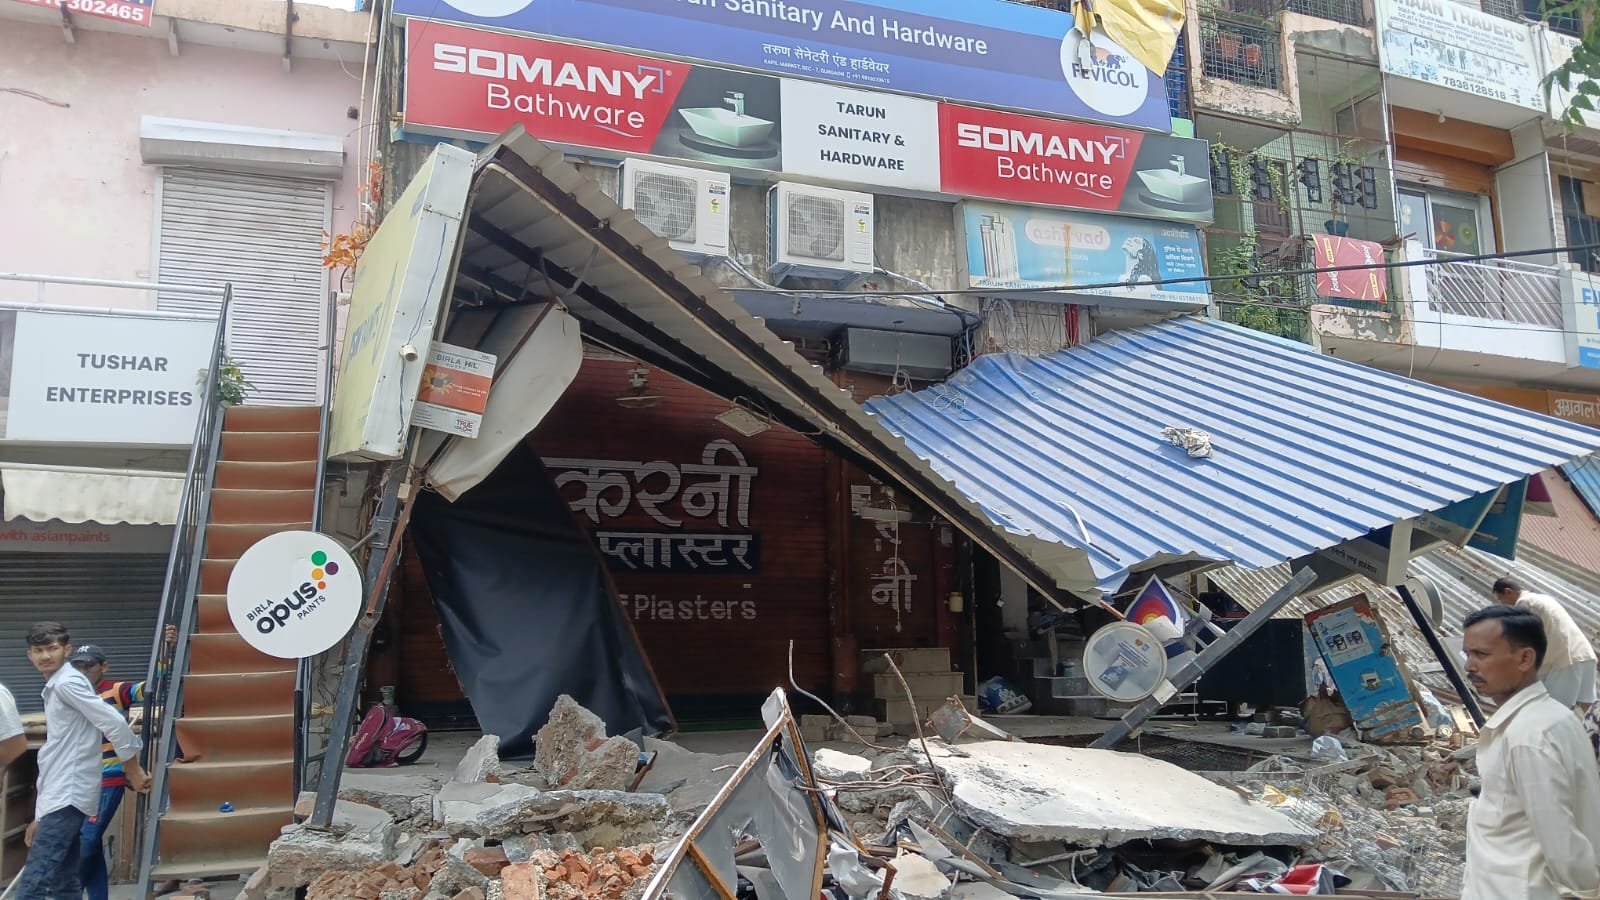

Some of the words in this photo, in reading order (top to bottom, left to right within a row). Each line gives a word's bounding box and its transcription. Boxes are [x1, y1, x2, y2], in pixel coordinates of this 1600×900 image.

[724, 0, 824, 31] Sanitary
[831, 10, 876, 36] And
[882, 17, 988, 55] Hardware
[1448, 2, 1526, 42] TRADERS
[434, 43, 658, 100] SOMANY
[762, 44, 790, 57] तरुण
[794, 45, 829, 64] सेनेटरी
[832, 52, 847, 67] एंड
[850, 55, 890, 74] हार्डवेयर
[1072, 62, 1139, 88] FEVICOL
[487, 83, 645, 129] Bathware
[836, 101, 887, 120] TARUN
[818, 124, 891, 146] SANITARY
[893, 135, 906, 148] &
[958, 122, 1120, 165] SOMANY
[820, 149, 905, 171] HARDWARE
[998, 156, 1114, 190] Bathware
[77, 353, 168, 372] TUSHAR
[436, 354, 461, 365] BIRLA
[46, 387, 192, 406] ENTERPRISES
[540, 439, 759, 528] करनी
[32, 531, 111, 546] asianpaints
[596, 531, 752, 569] प्लास्टर
[246, 599, 274, 621] BIRLA
[256, 582, 318, 634] opus
[297, 595, 326, 620] PAINTS
[634, 594, 757, 620] Plasters
